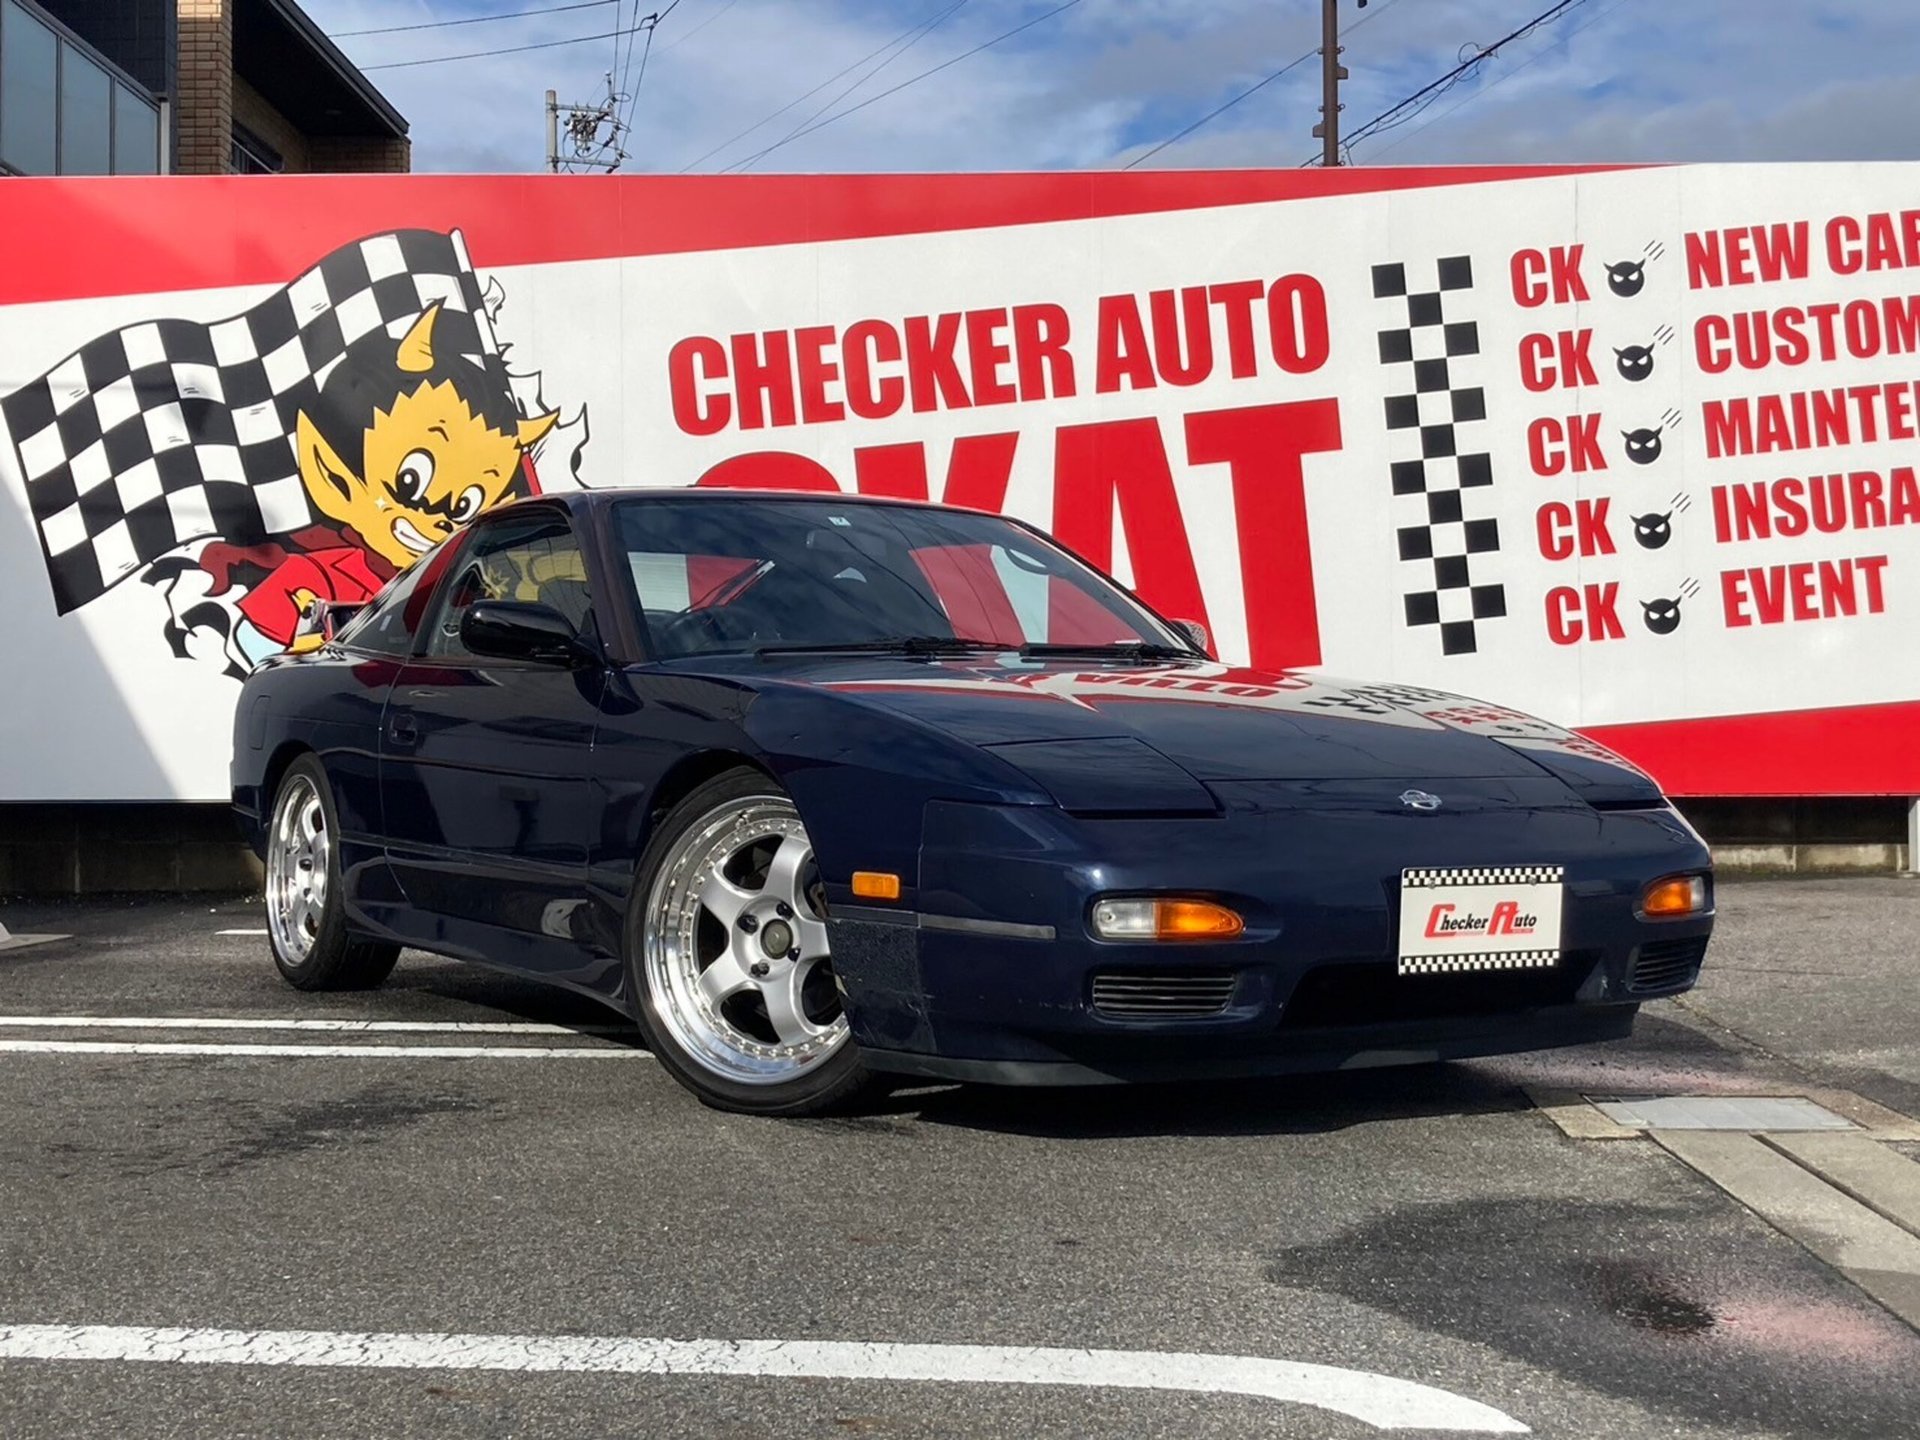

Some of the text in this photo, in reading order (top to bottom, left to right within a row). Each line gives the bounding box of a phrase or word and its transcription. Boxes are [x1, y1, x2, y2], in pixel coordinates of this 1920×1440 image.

[1511, 245, 1590, 307] CK
[1685, 221, 1809, 289] NEW
[669, 273, 1330, 436] CHECKER AUTO
[1519, 295, 1920, 392] CK CUSTOM
[1528, 380, 1920, 477] CK MAINTE
[692, 398, 1343, 668] KAT
[1537, 498, 1617, 561] CK
[1545, 556, 1888, 646] CK EVENT
[1424, 901, 1537, 938] Checker Auto
